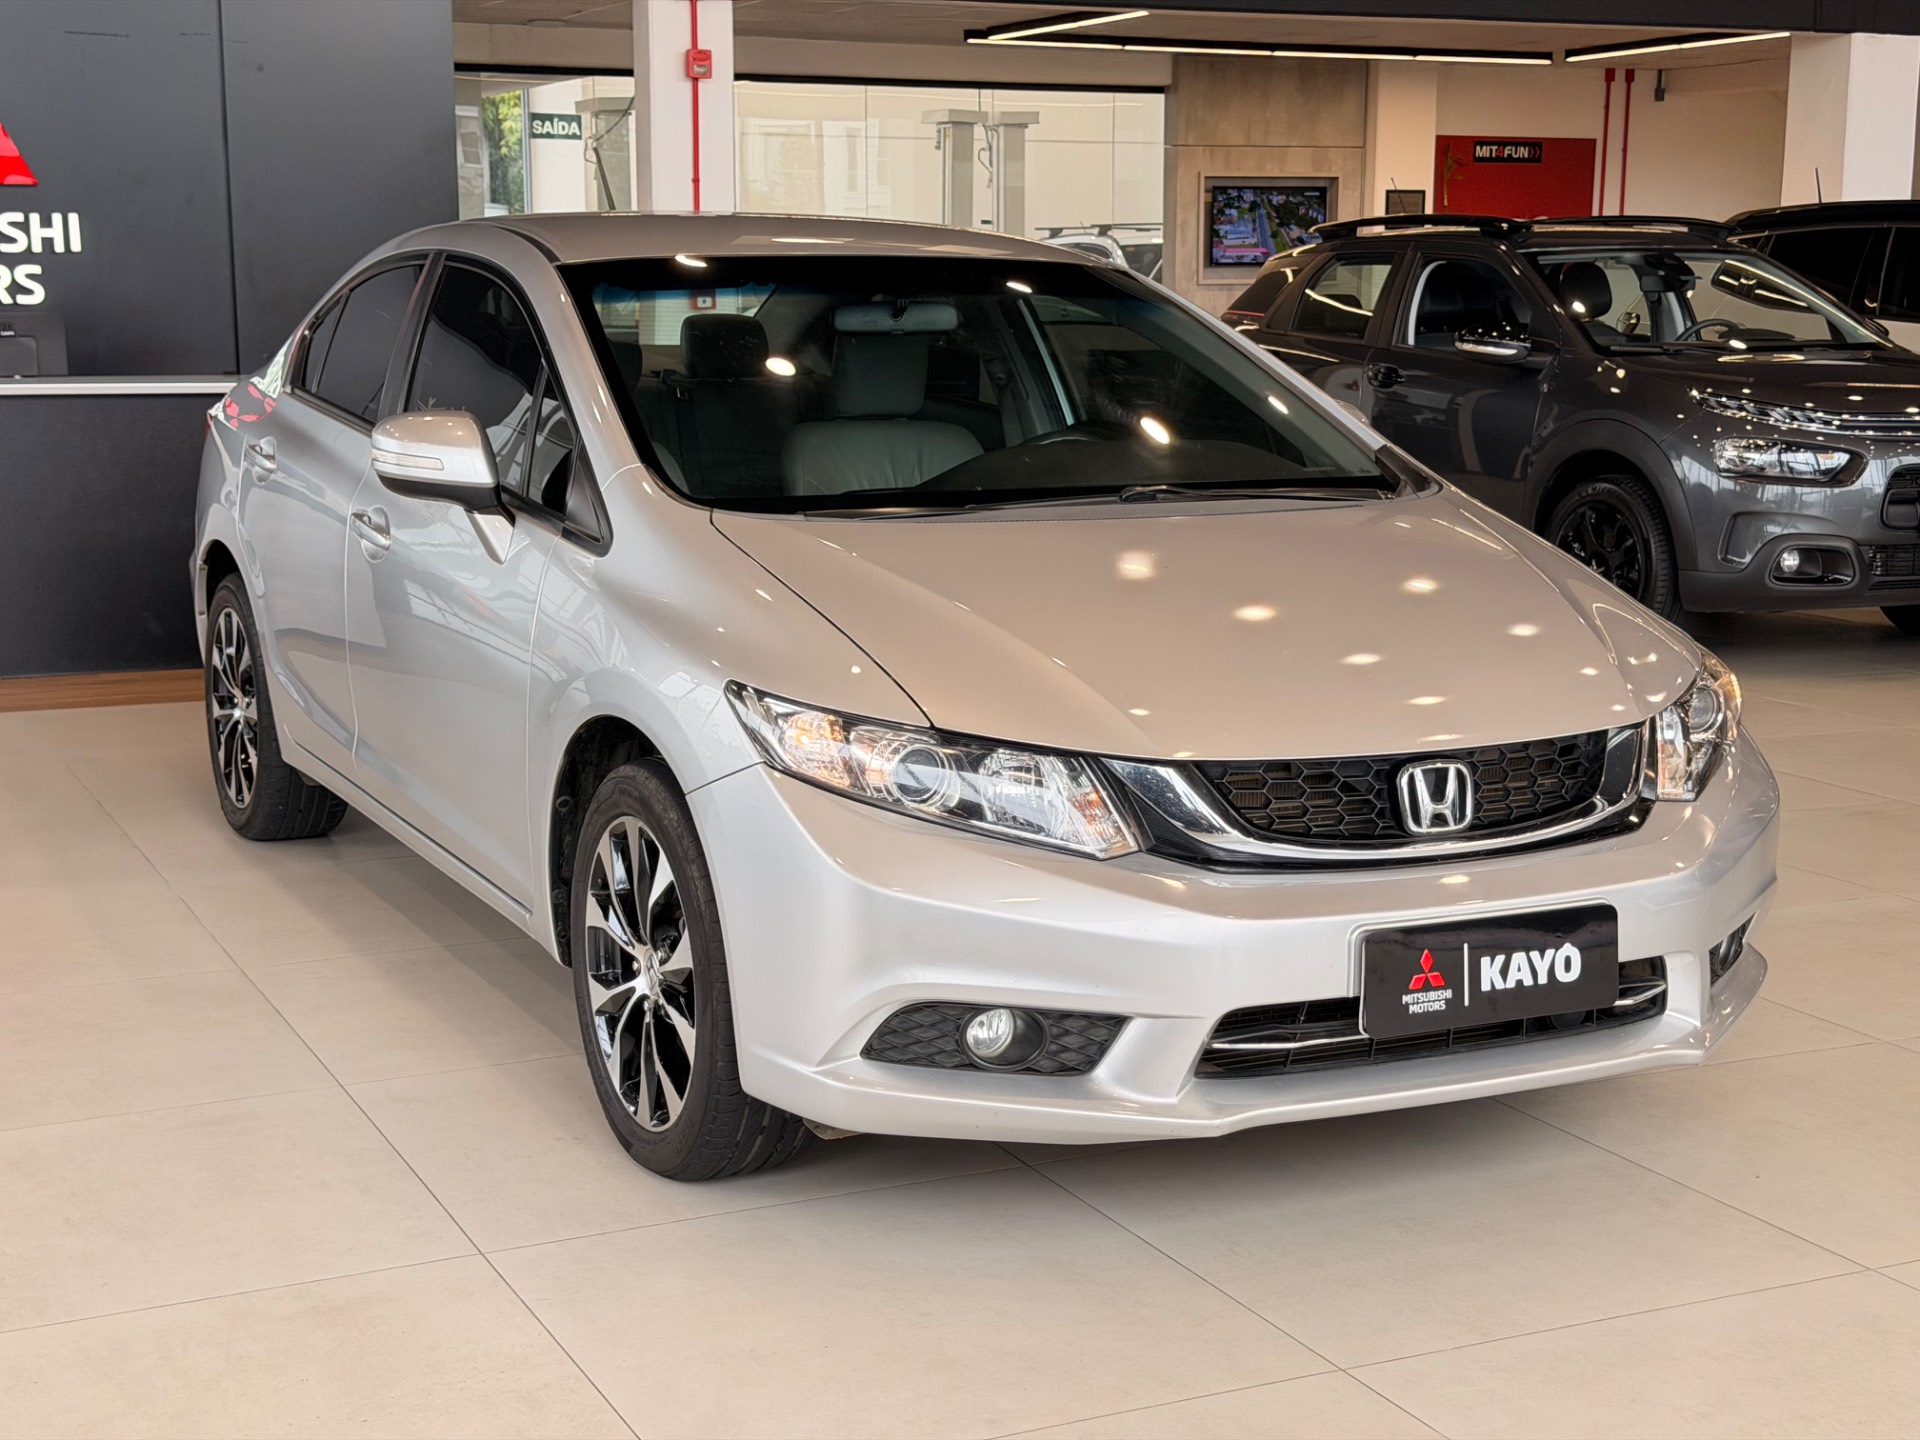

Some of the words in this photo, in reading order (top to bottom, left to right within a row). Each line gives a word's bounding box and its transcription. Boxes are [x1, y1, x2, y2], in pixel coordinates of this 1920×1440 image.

[532, 117, 581, 136] SAÍDA
[0, 211, 82, 253] SHI
[1402, 989, 1453, 1005] MITSUBISHI
[1409, 1000, 1446, 1014] MOTORS
